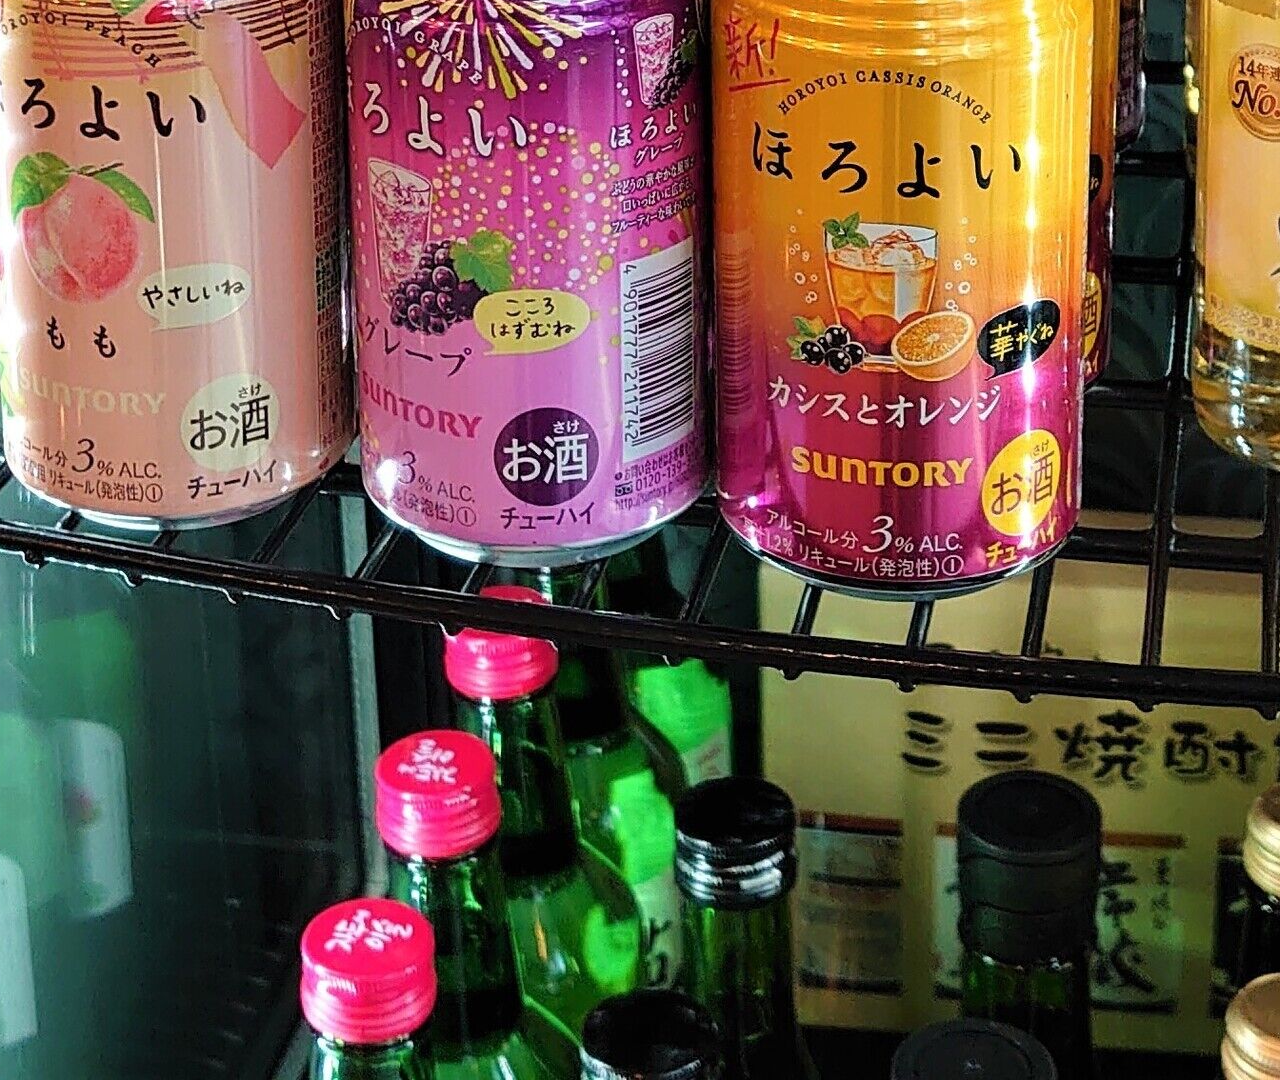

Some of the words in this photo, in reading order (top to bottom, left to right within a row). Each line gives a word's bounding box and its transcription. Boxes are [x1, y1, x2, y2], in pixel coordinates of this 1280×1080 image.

[85, 20, 161, 70] PEACH
[414, 31, 484, 85] GRAPE
[349, 70, 527, 157] ろよい
[778, 72, 848, 116] HOROYOI
[855, 70, 927, 89] CASSIS
[930, 80, 993, 125] ORANGE
[752, 122, 1022, 199] ほろよい
[141, 278, 246, 311] やさしいね
[505, 296, 556, 316] こころ
[46, 316, 117, 359] もも
[490, 317, 576, 341] はずむね
[623, 288, 639, 360] 901777
[989, 319, 1055, 362] 華やぐね
[19, 369, 168, 415] SUNTORY
[237, 384, 262, 399] さけ
[362, 370, 483, 440] SUNTORY
[624, 371, 640, 443] 211742
[766, 376, 1002, 428] カシスとオレンジ
[189, 394, 271, 452] お酒
[553, 420, 580, 434] さけ
[120, 462, 162, 479] ALC.
[187, 460, 279, 500] チューハイ
[502, 432, 590, 484] お酒
[791, 445, 975, 488] SUNTORY
[437, 481, 476, 503] ALC.
[991, 451, 1055, 516] お酒
[500, 502, 596, 531] チューハイ
[766, 508, 859, 550] アルコール分
[919, 532, 964, 553] ALC.
